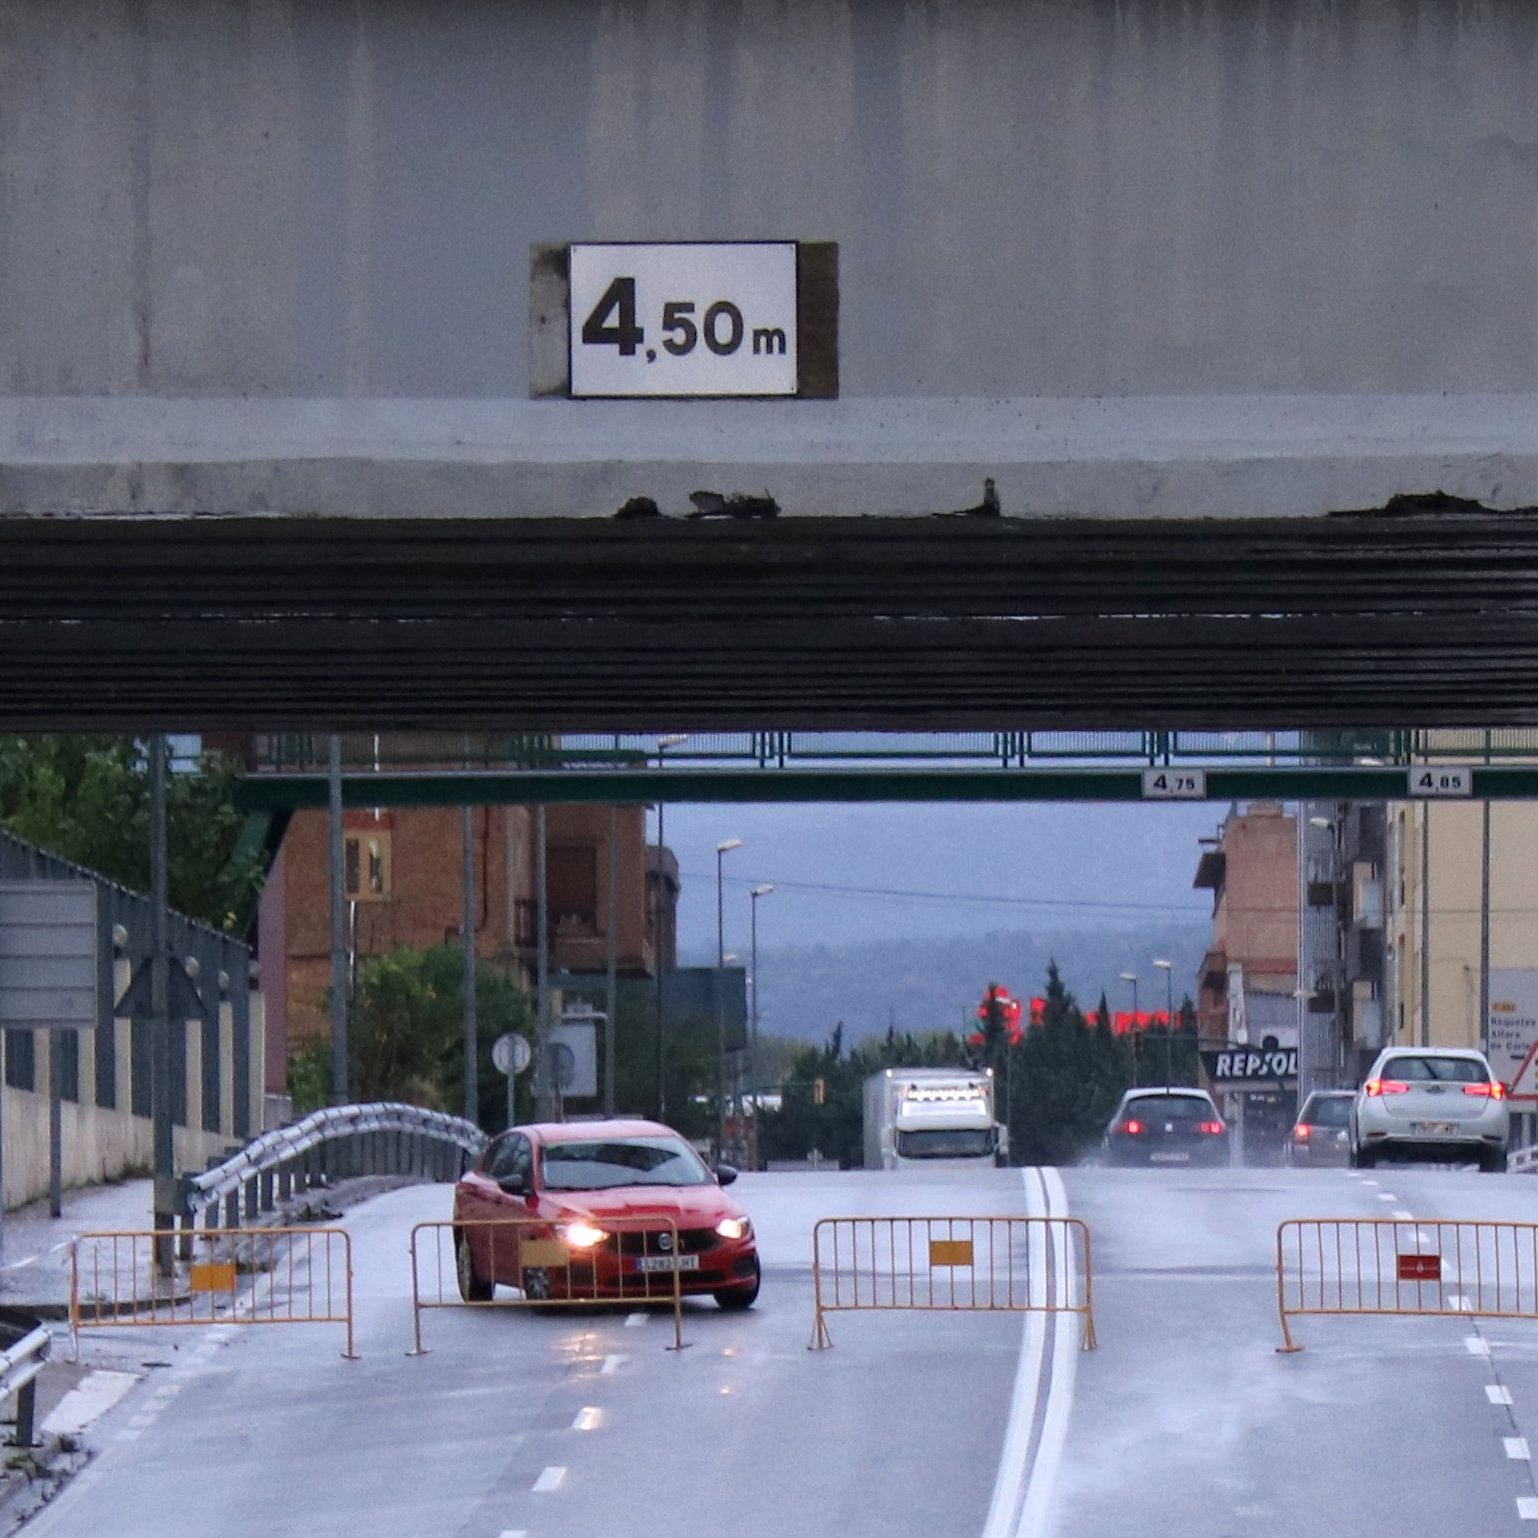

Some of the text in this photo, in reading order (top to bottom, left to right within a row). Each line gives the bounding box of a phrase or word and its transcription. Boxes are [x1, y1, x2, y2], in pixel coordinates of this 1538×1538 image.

[1153, 774, 1195, 794] 4,75
[1419, 772, 1461, 793] 4,85
[1215, 1052, 1298, 1077] REPSOL
